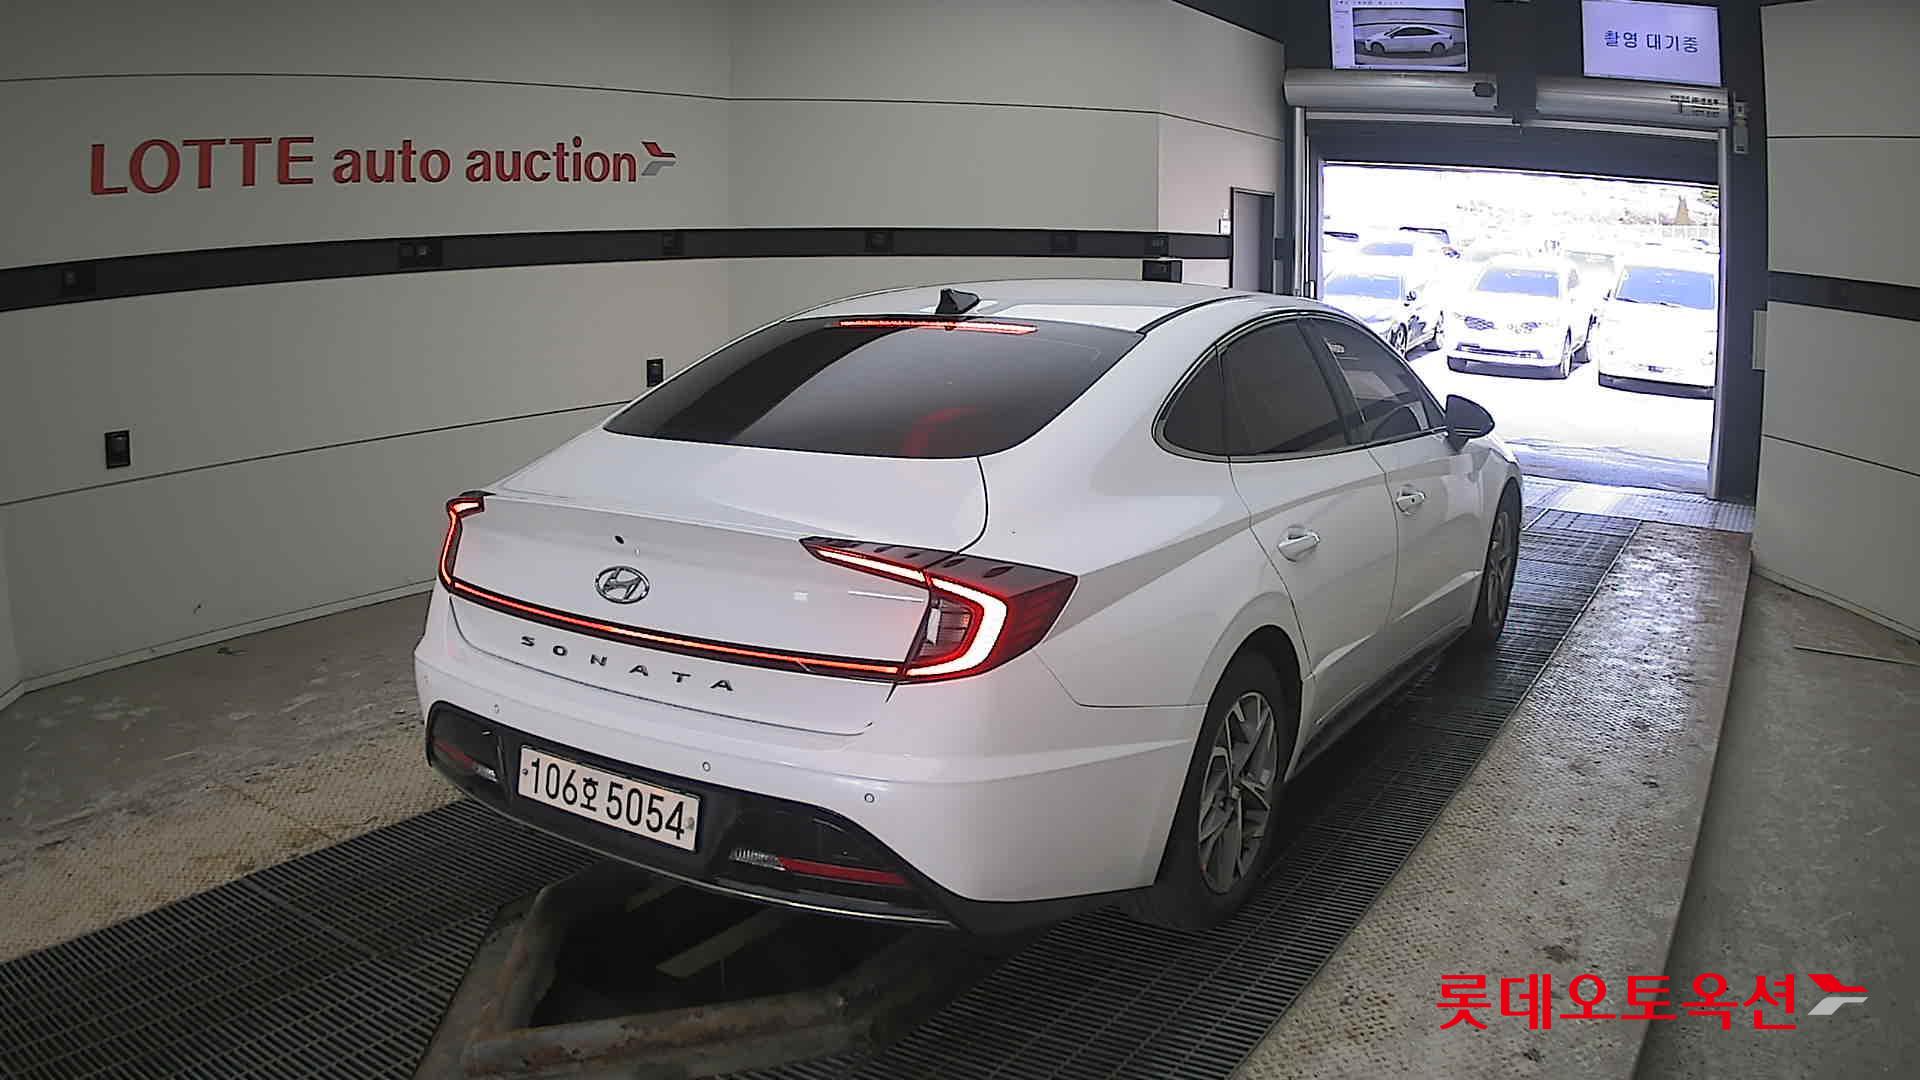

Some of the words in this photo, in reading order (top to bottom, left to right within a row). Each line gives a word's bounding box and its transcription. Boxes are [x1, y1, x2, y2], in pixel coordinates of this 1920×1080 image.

[1604, 30, 1638, 49] 촬영
[1646, 33, 1698, 53] 대기중
[91, 137, 314, 195] LOTTE
[332, 139, 451, 184] auto
[465, 136, 638, 184] auction
[520, 635, 734, 692] SONATA
[605, 781, 685, 840] 5054
